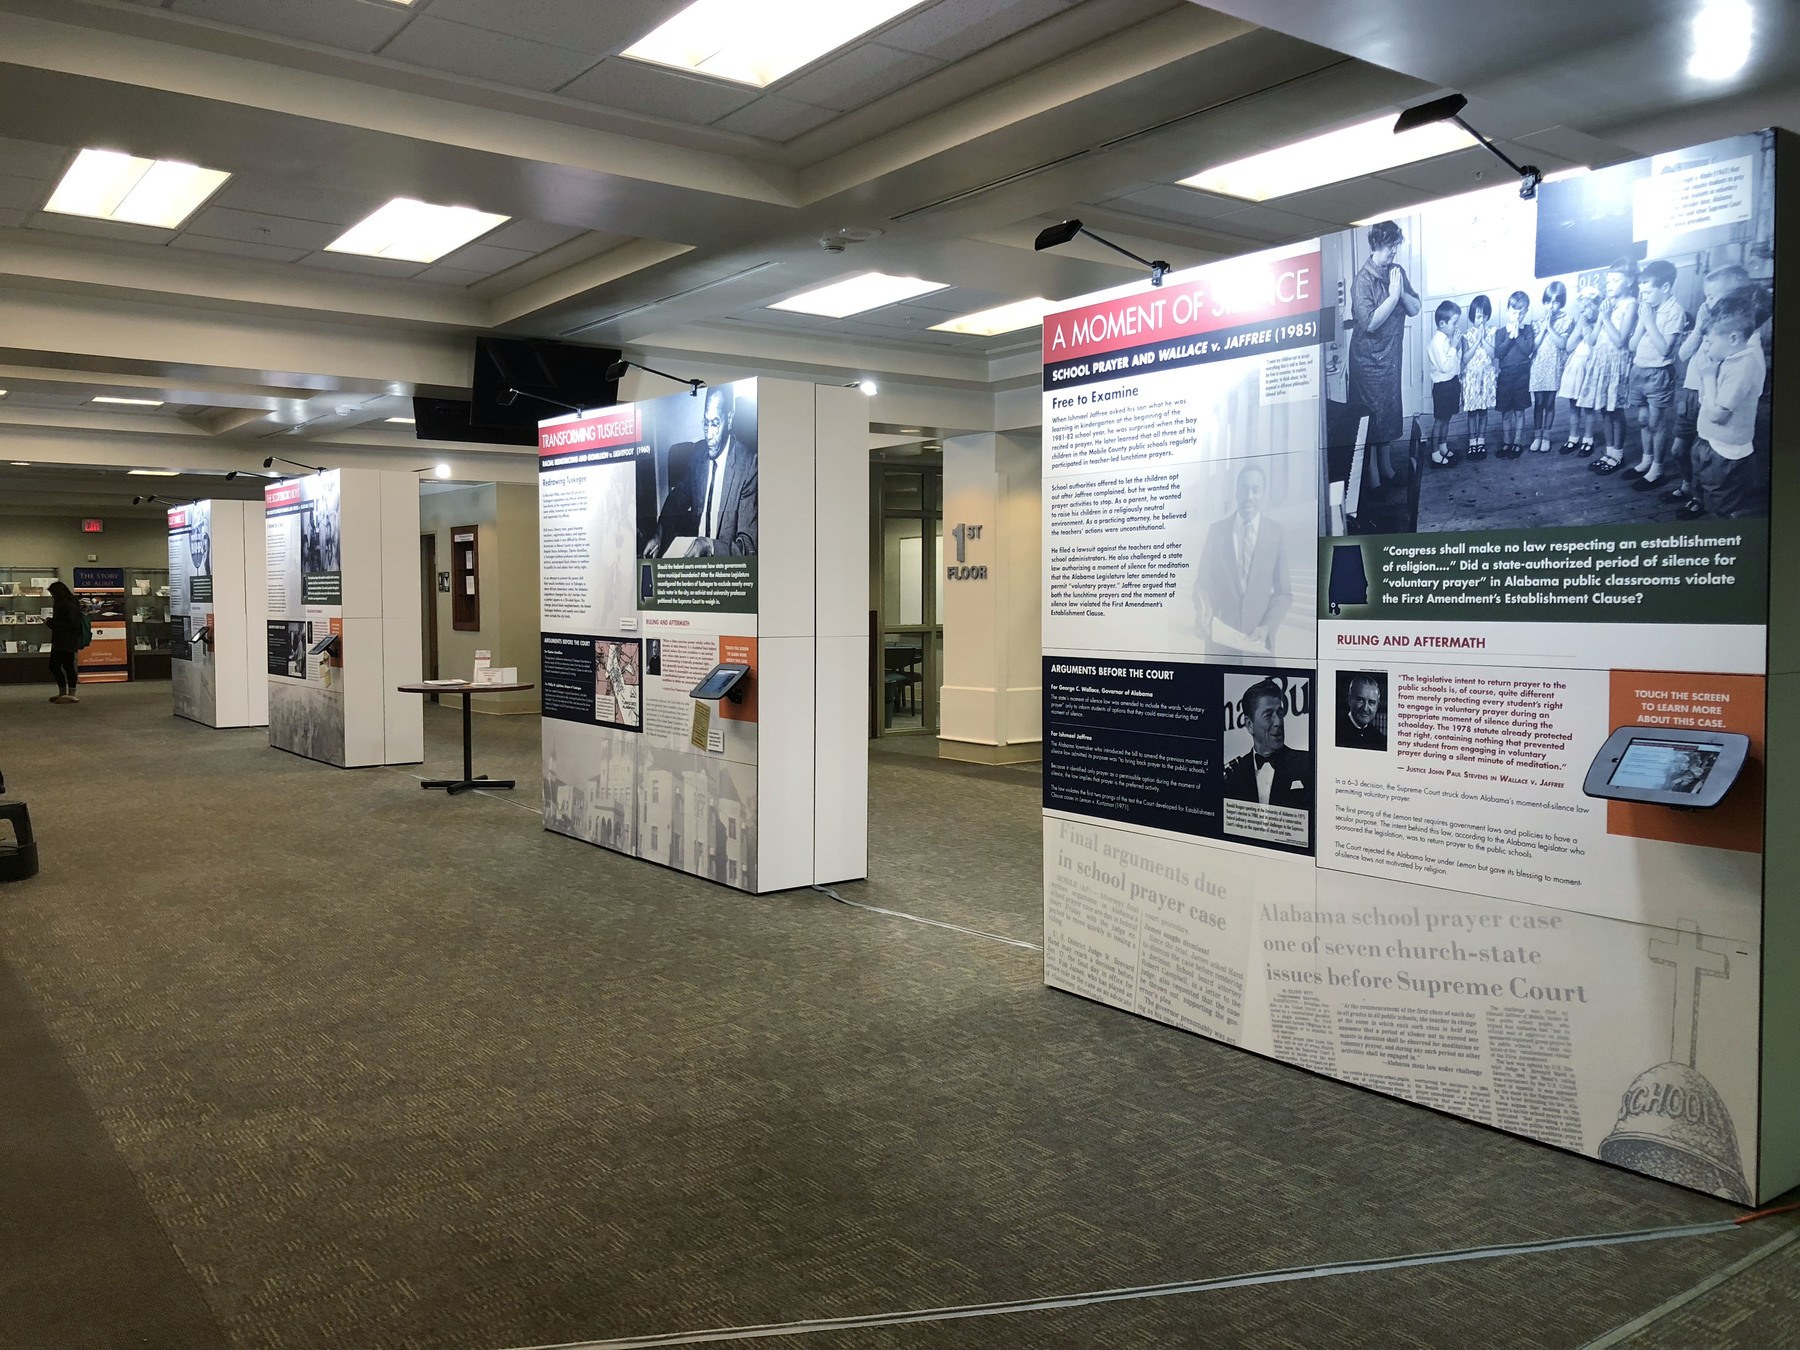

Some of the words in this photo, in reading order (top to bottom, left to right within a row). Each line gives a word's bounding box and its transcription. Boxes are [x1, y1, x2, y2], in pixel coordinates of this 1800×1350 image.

[1052, 324, 1066, 351] A
[1071, 299, 1167, 347] MOMENT
[1172, 291, 1204, 325] OF
[1051, 363, 1090, 381] SCHOOL
[1092, 355, 1129, 374] PRAYER
[1130, 351, 1155, 367] AND
[1158, 340, 1208, 361] WALLACE
[1210, 342, 1220, 352] v.
[1223, 329, 1272, 350] JAFFREE
[1274, 321, 1316, 343] (1985)
[1052, 396, 1074, 409] Free
[1077, 394, 1087, 405] to
[1091, 385, 1138, 403] Examine
[542, 426, 596, 449] TRANSFORMING
[597, 420, 634, 440] TUSKEGEE
[542, 478, 566, 487] Redrawing
[566, 476, 587, 485] Tuskegee
[1051, 482, 1068, 491] School
[1068, 480, 1096, 489] authorities
[1096, 478, 1117, 486] offered
[1143, 474, 1167, 482] children
[1168, 473, 1179, 481] opt
[84, 520, 101, 532] EXIT
[1439, 542, 1465, 554] shall
[1468, 541, 1501, 553] make
[1504, 544, 1519, 552] no
[1522, 540, 1546, 552] law
[1549, 538, 1615, 554] respecting
[1618, 540, 1636, 549] an
[1640, 534, 1742, 548] establishment
[1382, 560, 1393, 572] of
[1459, 558, 1478, 570] Did
[1481, 561, 1489, 570] a
[1492, 556, 1592, 570] state-authorized
[1595, 554, 1639, 571] period
[1642, 554, 1658, 567] of
[1661, 553, 1710, 566] silence
[1713, 552, 1736, 565] for
[947, 566, 987, 581] FLOOR
[1489, 575, 1501, 586] in
[1503, 574, 1559, 586] Alabama
[1562, 573, 1601, 589] public
[1604, 573, 1680, 585] classrooms
[1684, 571, 1735, 584] violate
[1381, 592, 1398, 603] the
[1401, 592, 1424, 603] First
[1504, 591, 1589, 603] Establishment
[1591, 591, 1643, 603] Clause?
[1050, 608, 1085, 616] Establishment
[1336, 634, 1379, 646] RULING
[1382, 635, 1410, 646] AND
[1413, 635, 1485, 648] AFTERMATH
[1050, 663, 1096, 675] ARGUMENTS
[1098, 666, 1127, 677] BEFORE
[1128, 668, 1143, 678] THE
[1145, 669, 1174, 680] COURT
[1415, 674, 1452, 684] legislative
[1454, 676, 1476, 684] intent
[1513, 680, 1541, 689] prayer
[1552, 680, 1566, 689] the
[1634, 689, 1668, 699] TOUCH
[1669, 690, 1689, 700] THE
[1691, 692, 1730, 702] SCREEN
[1640, 702, 1655, 711] TO
[1656, 703, 1689, 712] LEARN
[1691, 705, 1721, 715] MORE
[1636, 714, 1671, 725] ABOUT
[1672, 716, 1695, 726] THIS
[1696, 717, 1726, 728] CASE.
[1059, 822, 1099, 852] Final
[1102, 843, 1189, 886] arguments
[1193, 871, 1227, 899] due
[1057, 848, 1072, 870] in
[1076, 860, 1125, 892] school
[1129, 881, 1185, 914] prayer
[1188, 905, 1226, 931] case
[1260, 904, 1346, 925] Alabama
[1351, 905, 1421, 926] school
[1424, 911, 1502, 933] prayer
[1509, 910, 1563, 931] case
[1263, 938, 1296, 952] one
[1301, 936, 1321, 954] of
[1324, 942, 1381, 957] seven
[1385, 938, 1542, 964] church-state
[1265, 962, 1323, 985] issues
[1326, 966, 1393, 989] before
[1396, 970, 1503, 998] Supreme
[1508, 976, 1588, 1003] Court
